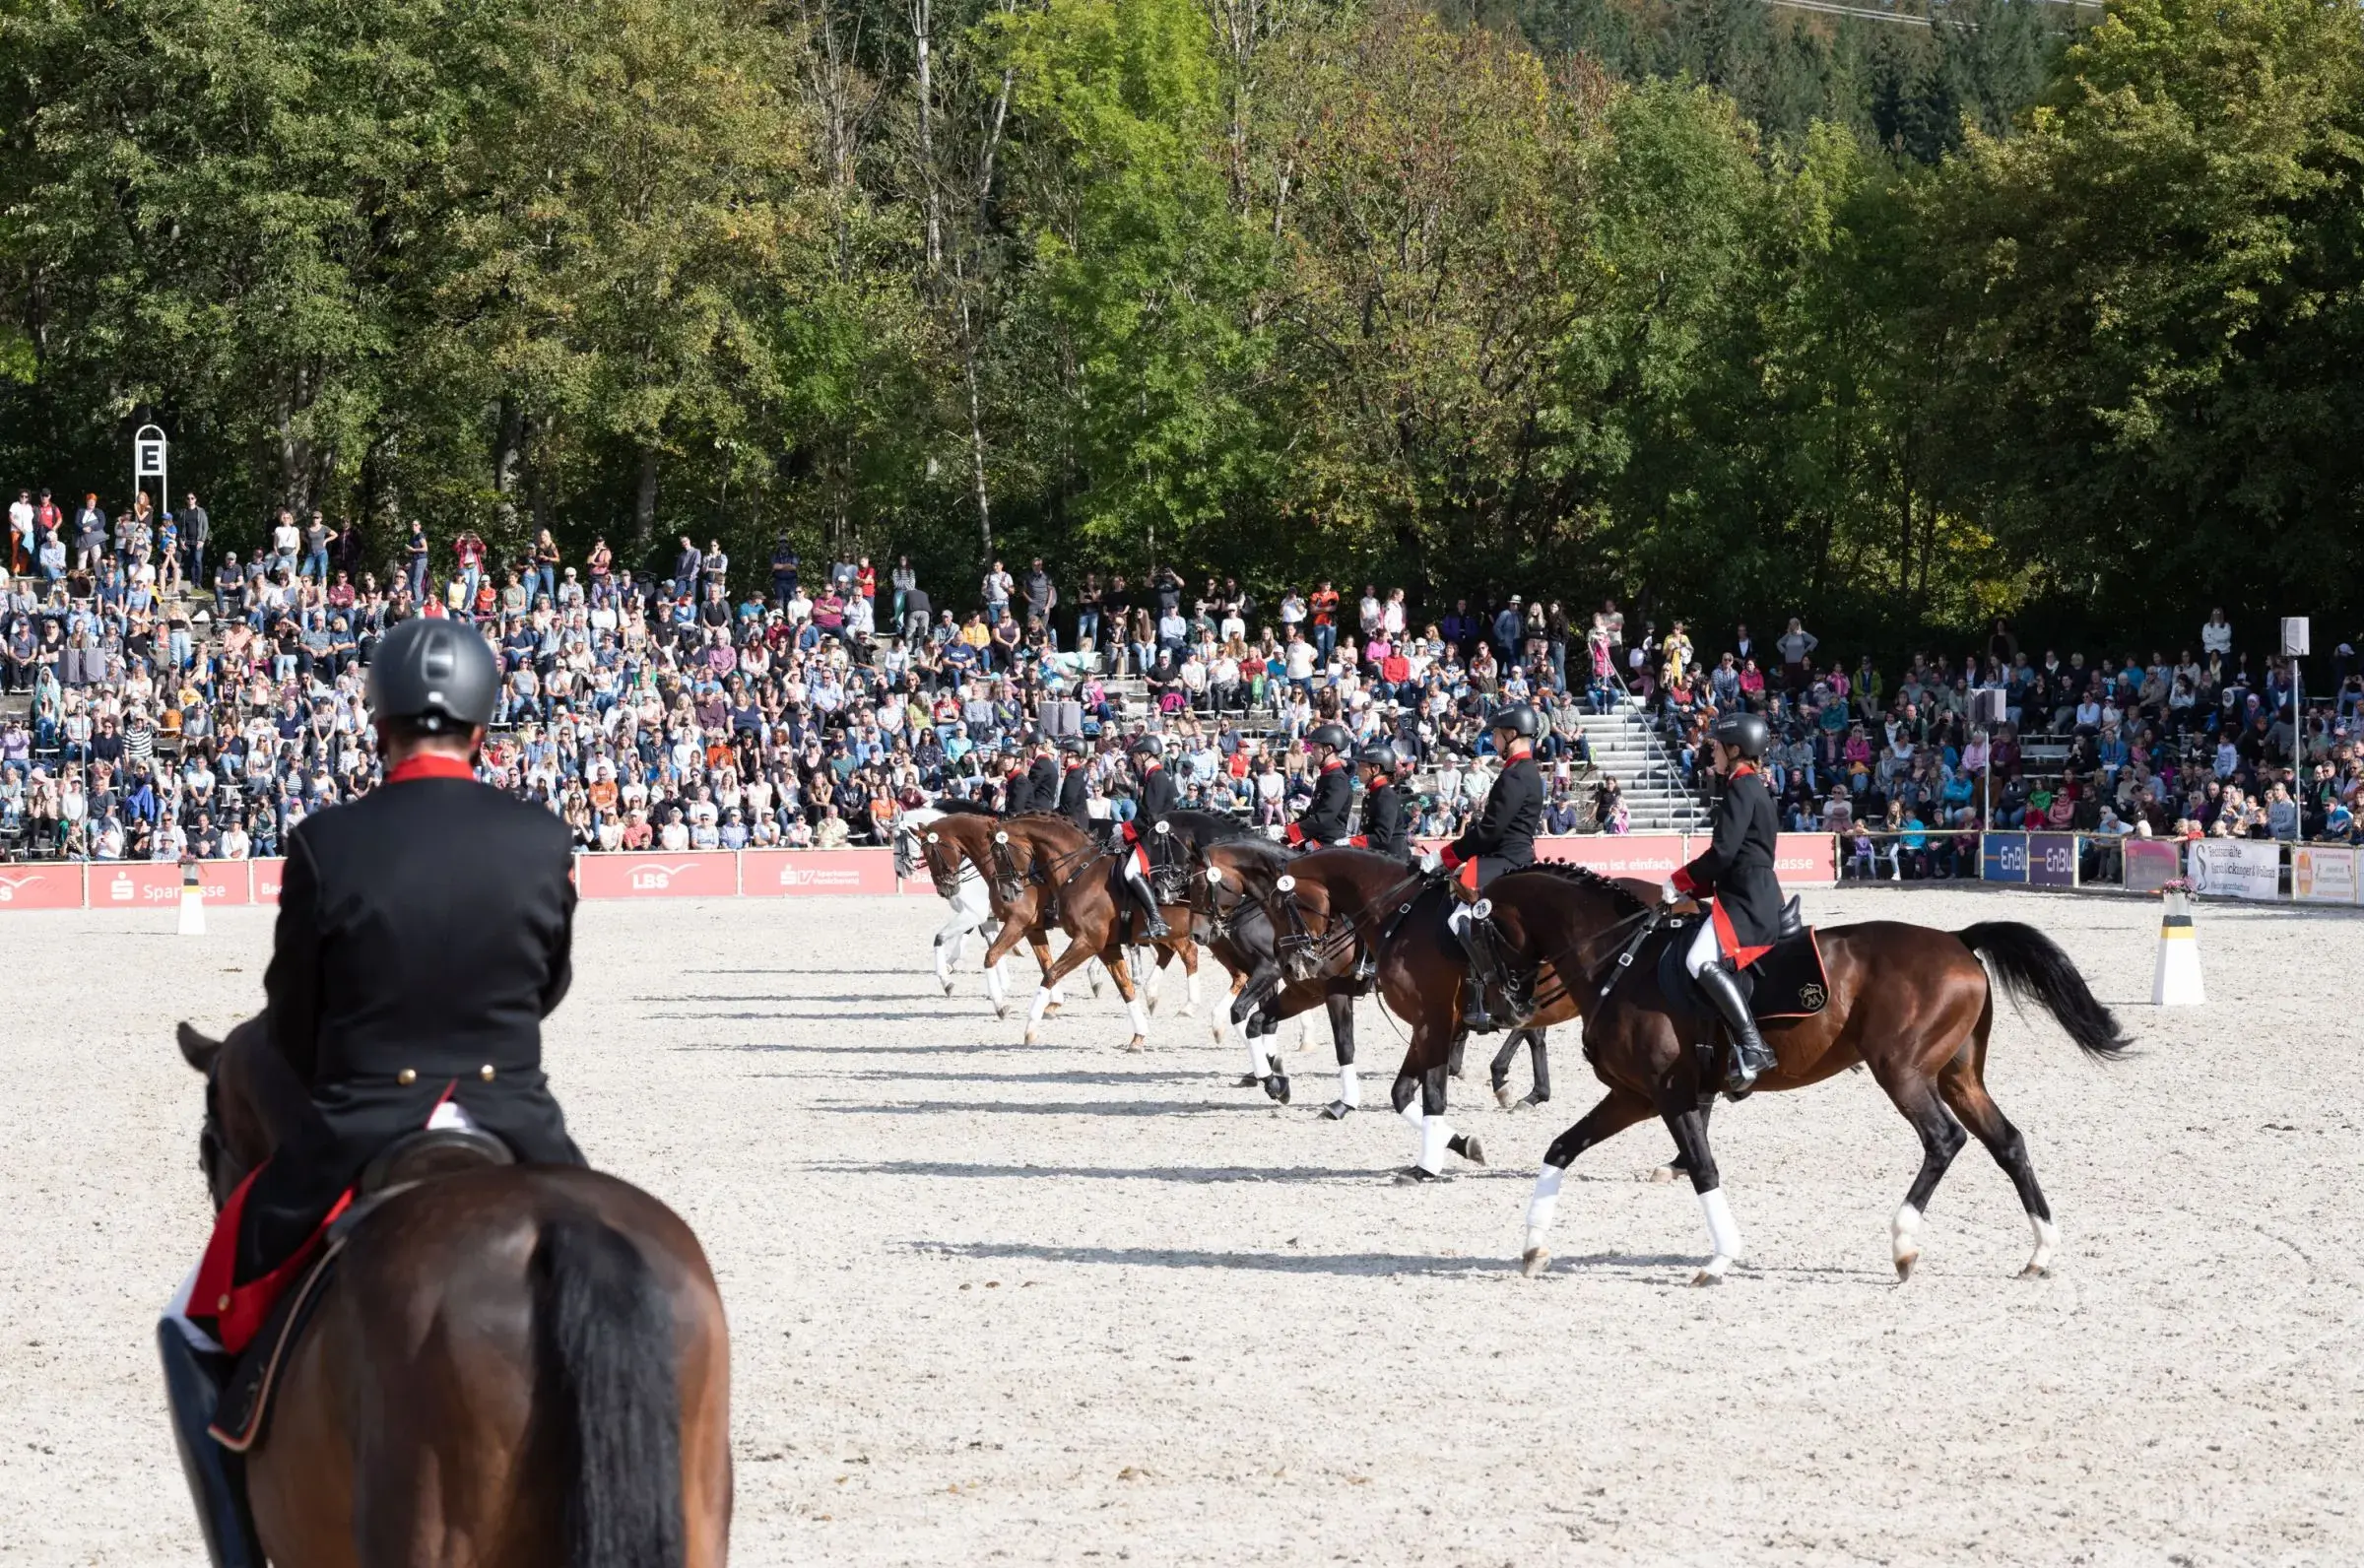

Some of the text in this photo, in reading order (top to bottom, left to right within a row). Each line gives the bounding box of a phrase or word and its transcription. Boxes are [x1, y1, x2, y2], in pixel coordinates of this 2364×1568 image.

[142, 445, 160, 471] E
[1609, 858, 1625, 871] ist
[1628, 857, 1676, 871] einfach.
[1774, 858, 1814, 870] kasse
[632, 874, 669, 889] LBS
[0, 885, 13, 901] S
[143, 883, 226, 901] Sparsse
